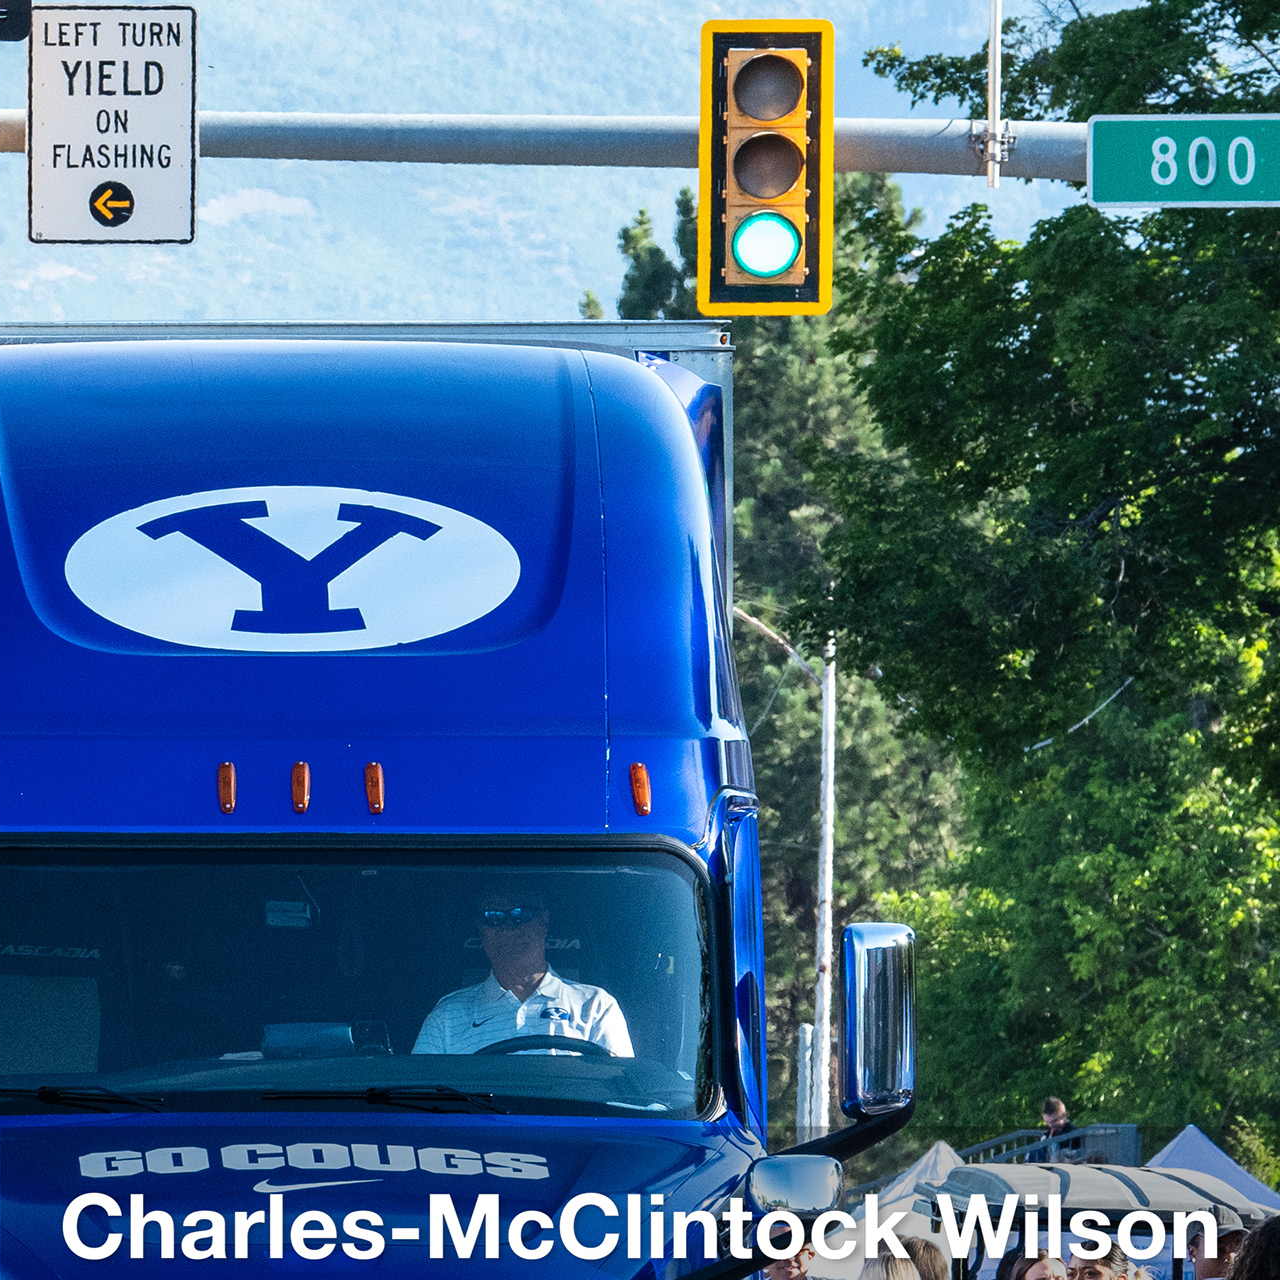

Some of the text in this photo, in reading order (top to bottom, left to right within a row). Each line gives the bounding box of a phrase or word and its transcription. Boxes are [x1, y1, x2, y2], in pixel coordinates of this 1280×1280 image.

[43, 22, 182, 47] LEFT TURN
[61, 60, 165, 97] YIELD
[96, 110, 129, 135] ON
[52, 144, 173, 169] FLASHING
[1150, 136, 1256, 187] 800
[136, 500, 442, 635] Y
[78, 1142, 551, 1180] GO COUGS
